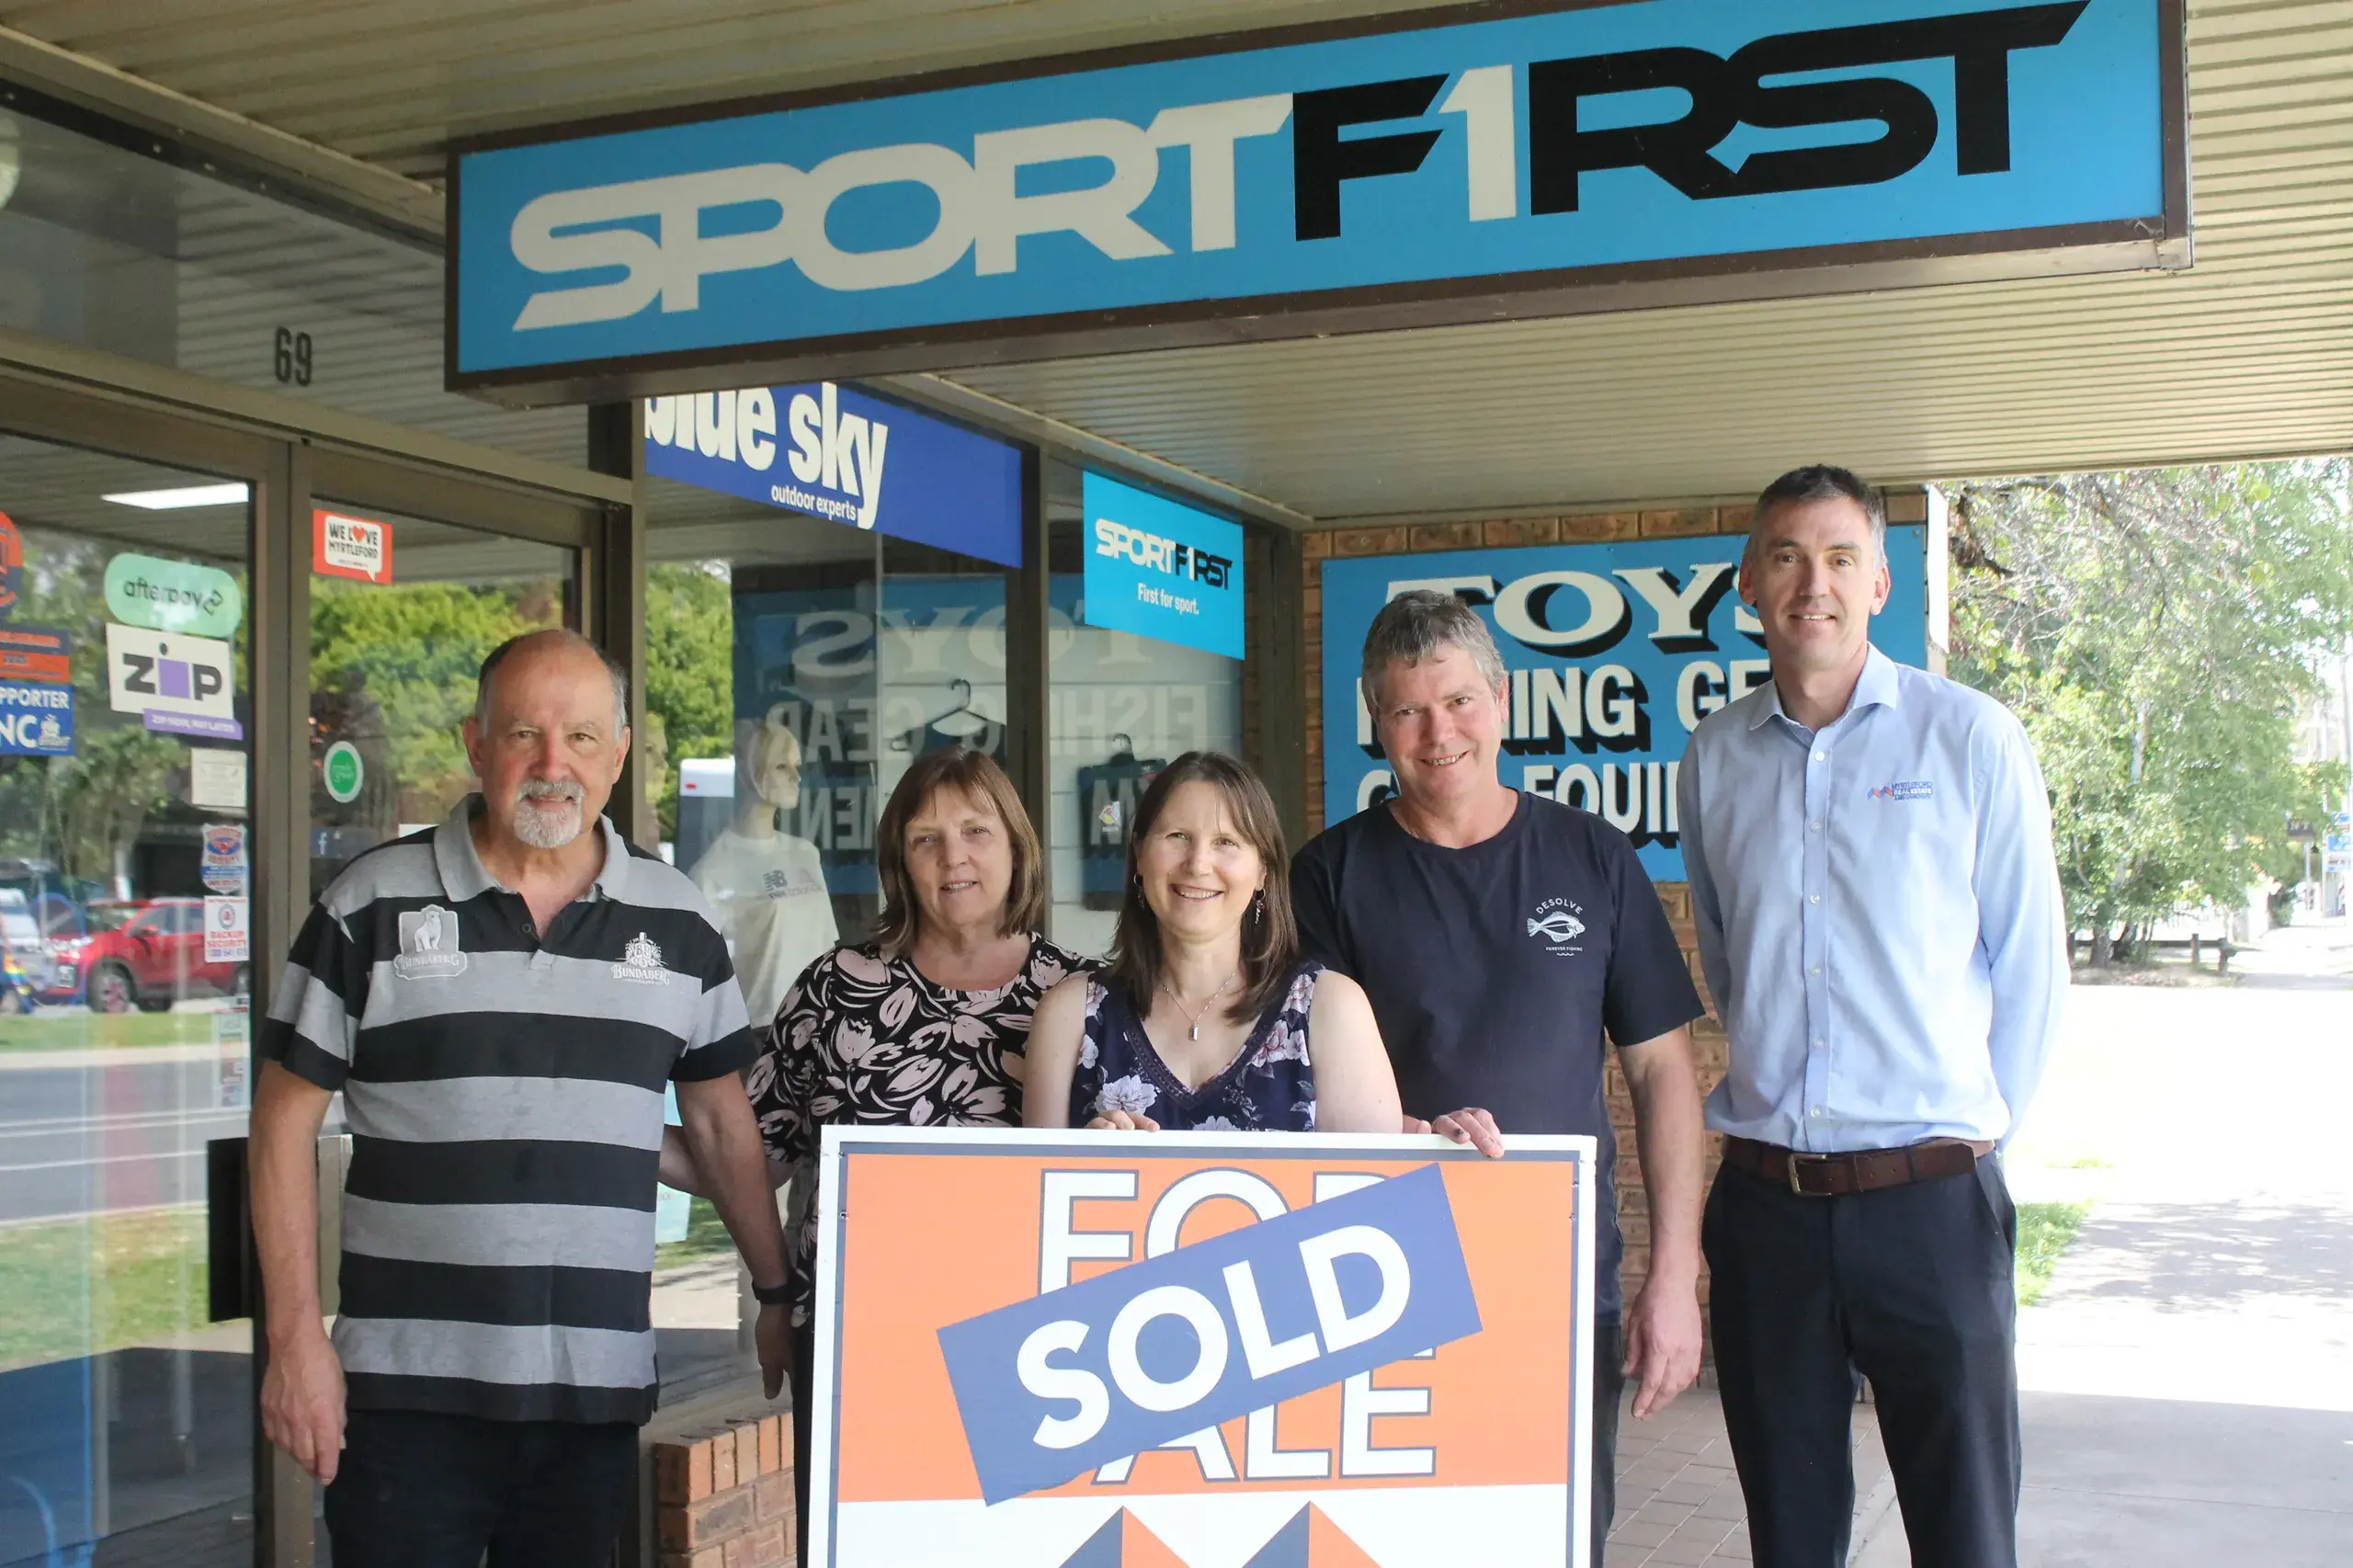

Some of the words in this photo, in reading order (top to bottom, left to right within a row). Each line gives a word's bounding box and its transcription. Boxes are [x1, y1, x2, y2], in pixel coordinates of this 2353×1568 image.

[275, 326, 313, 387] 69
[788, 381, 888, 529] sky
[770, 484, 815, 511] outdoor
[816, 496, 857, 522] experts
[328, 523, 346, 540] WE
[328, 540, 379, 559] MYRTLEFORD
[123, 577, 204, 608] afterpay
[1137, 583, 1159, 606] First
[1160, 589, 1173, 608] for
[1175, 597, 1199, 616] sport.
[1386, 561, 1763, 646] OY
[1535, 897, 1584, 915] DESOLVE
[611, 964, 670, 985] BUNDABERG
[1016, 1224, 1412, 1449] SOLD
